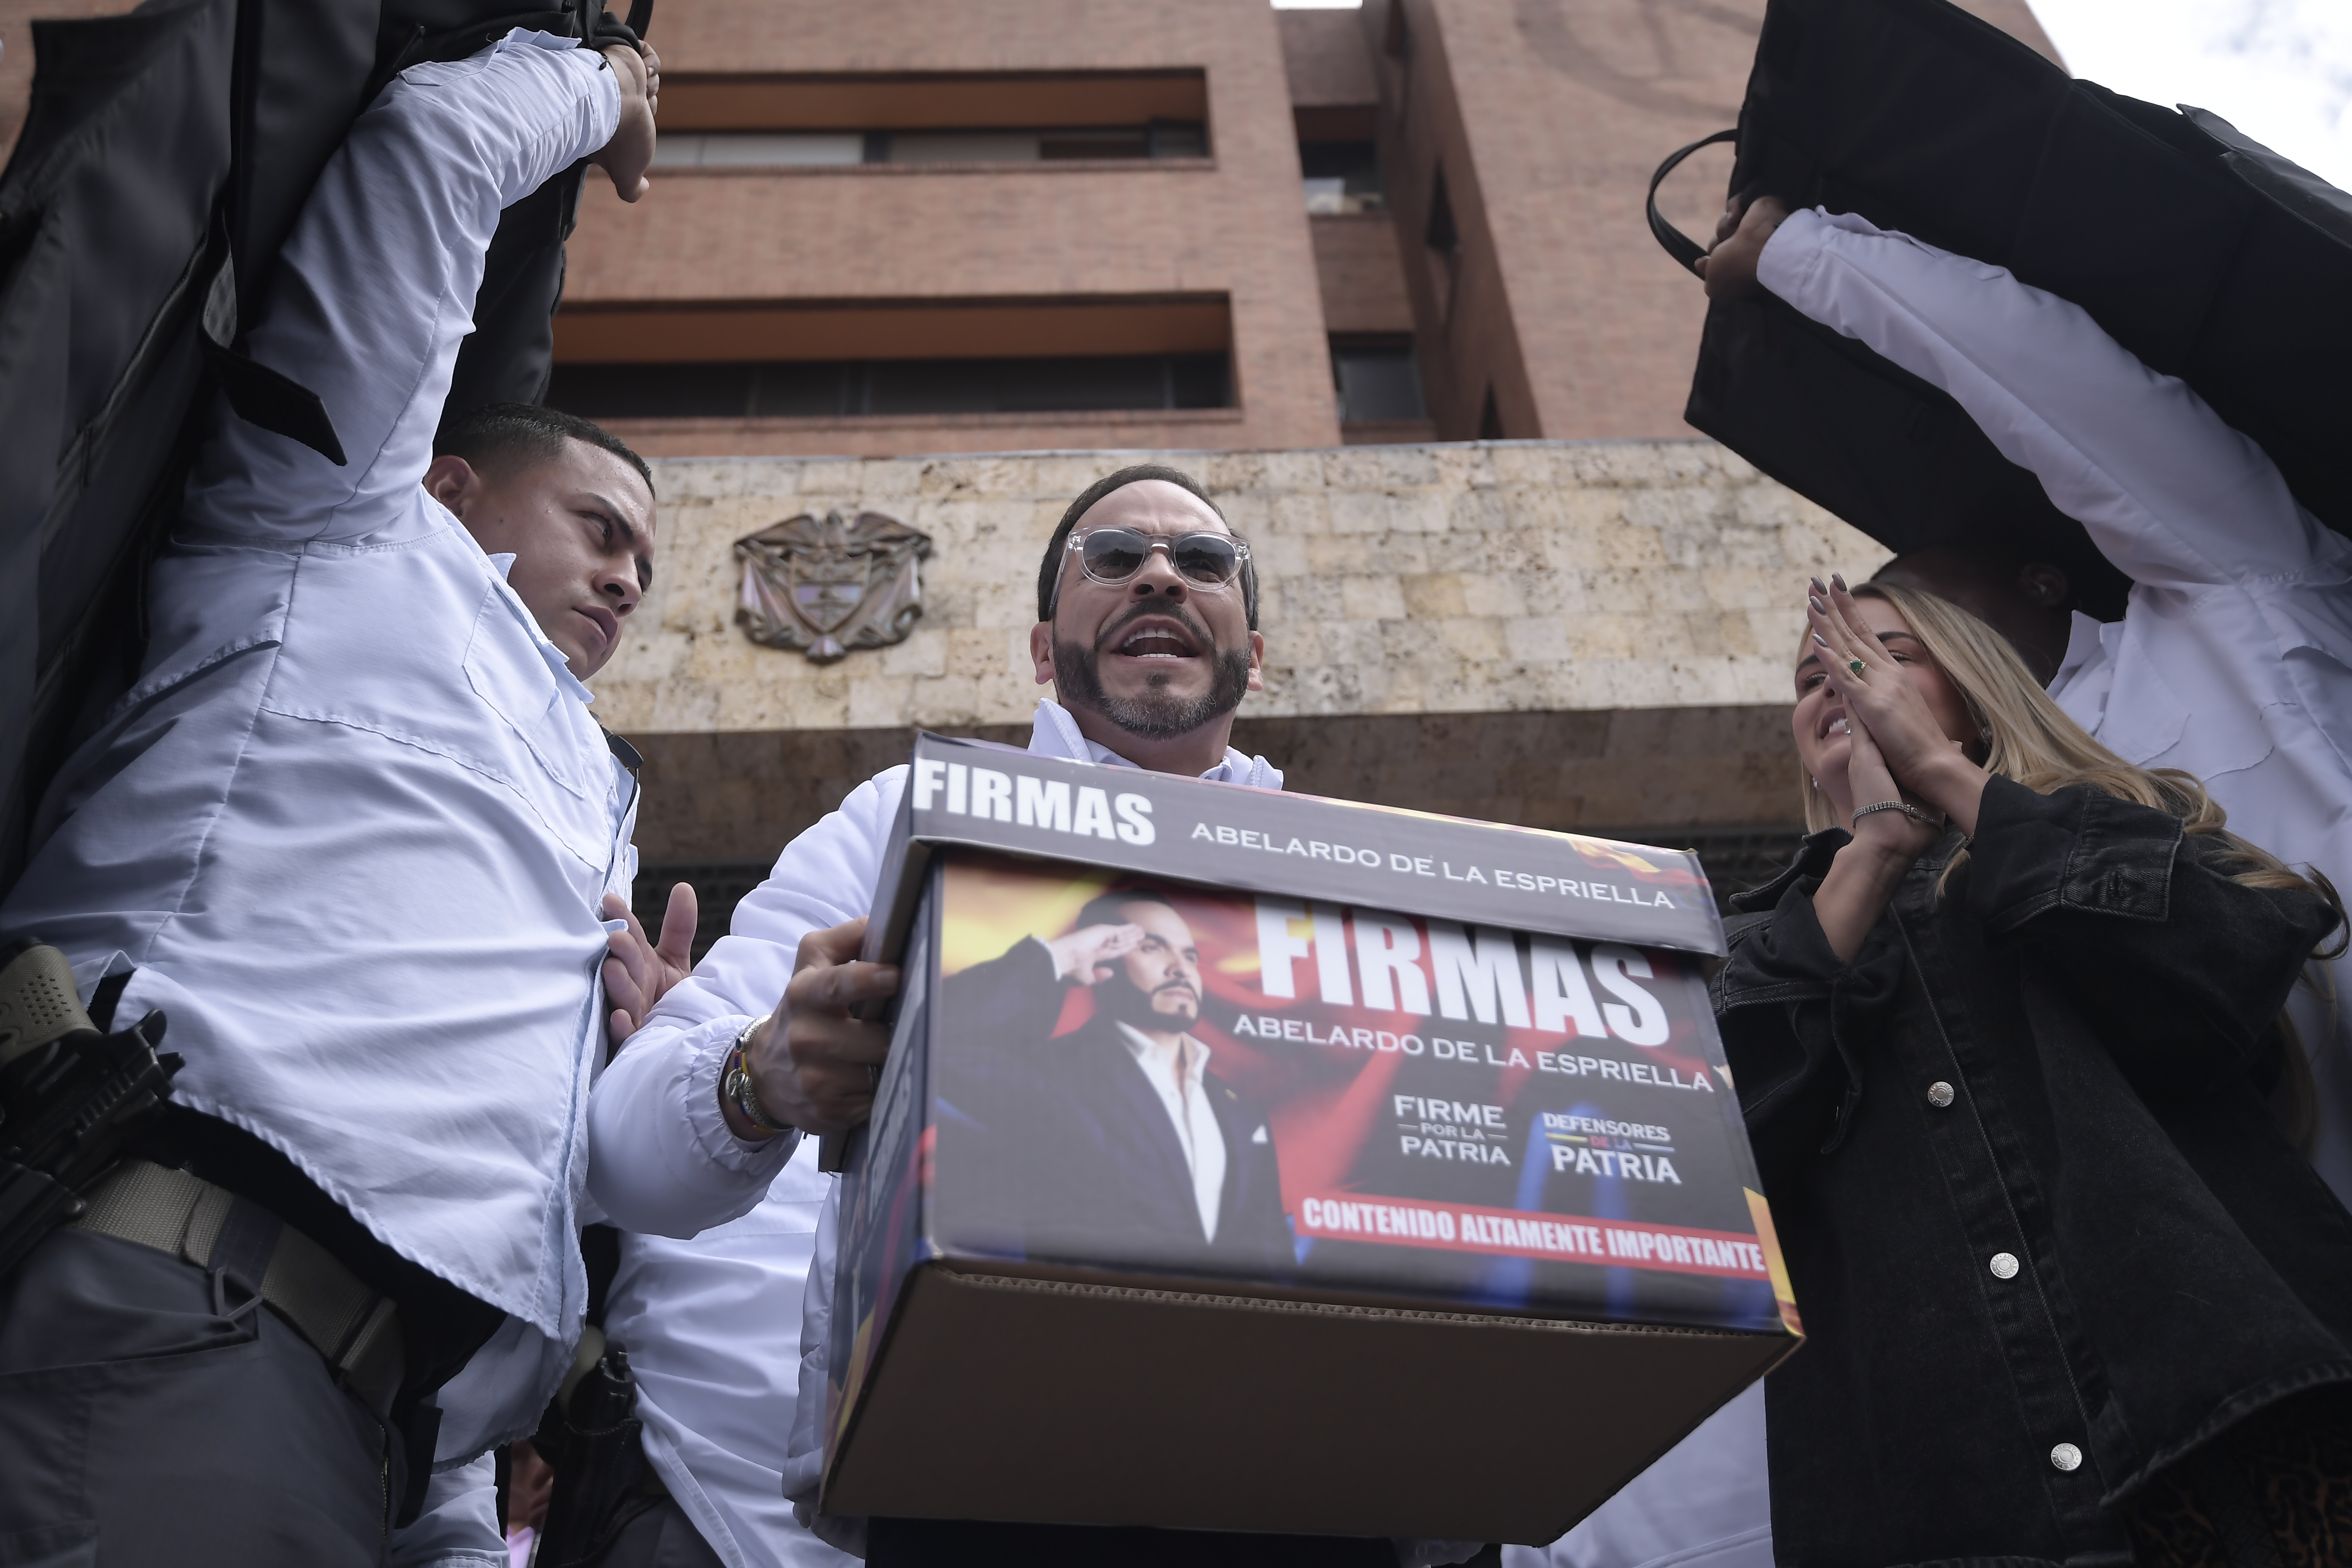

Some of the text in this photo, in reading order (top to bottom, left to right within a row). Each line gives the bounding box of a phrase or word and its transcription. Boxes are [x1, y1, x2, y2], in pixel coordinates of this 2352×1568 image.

[912, 757, 1676, 909] FIRMAS ABELARDO DE LA ESPRIELLA
[1255, 894, 1671, 1047] FIRMAS
[1233, 1013, 1715, 1093] ABELARDO DE LA ESPRIELLA
[1394, 1094, 1507, 1128] FIRME
[1542, 1112, 1671, 1141] DEFENSORES
[1421, 1122, 1485, 1139] POR LA
[1589, 1135, 1632, 1150] DE LA
[1400, 1135, 1512, 1166] PATRIA
[1550, 1143, 1682, 1184] PATRIA
[1303, 1197, 1765, 1271] CONTENIDO ALTAMENTE IMPORTANTE
